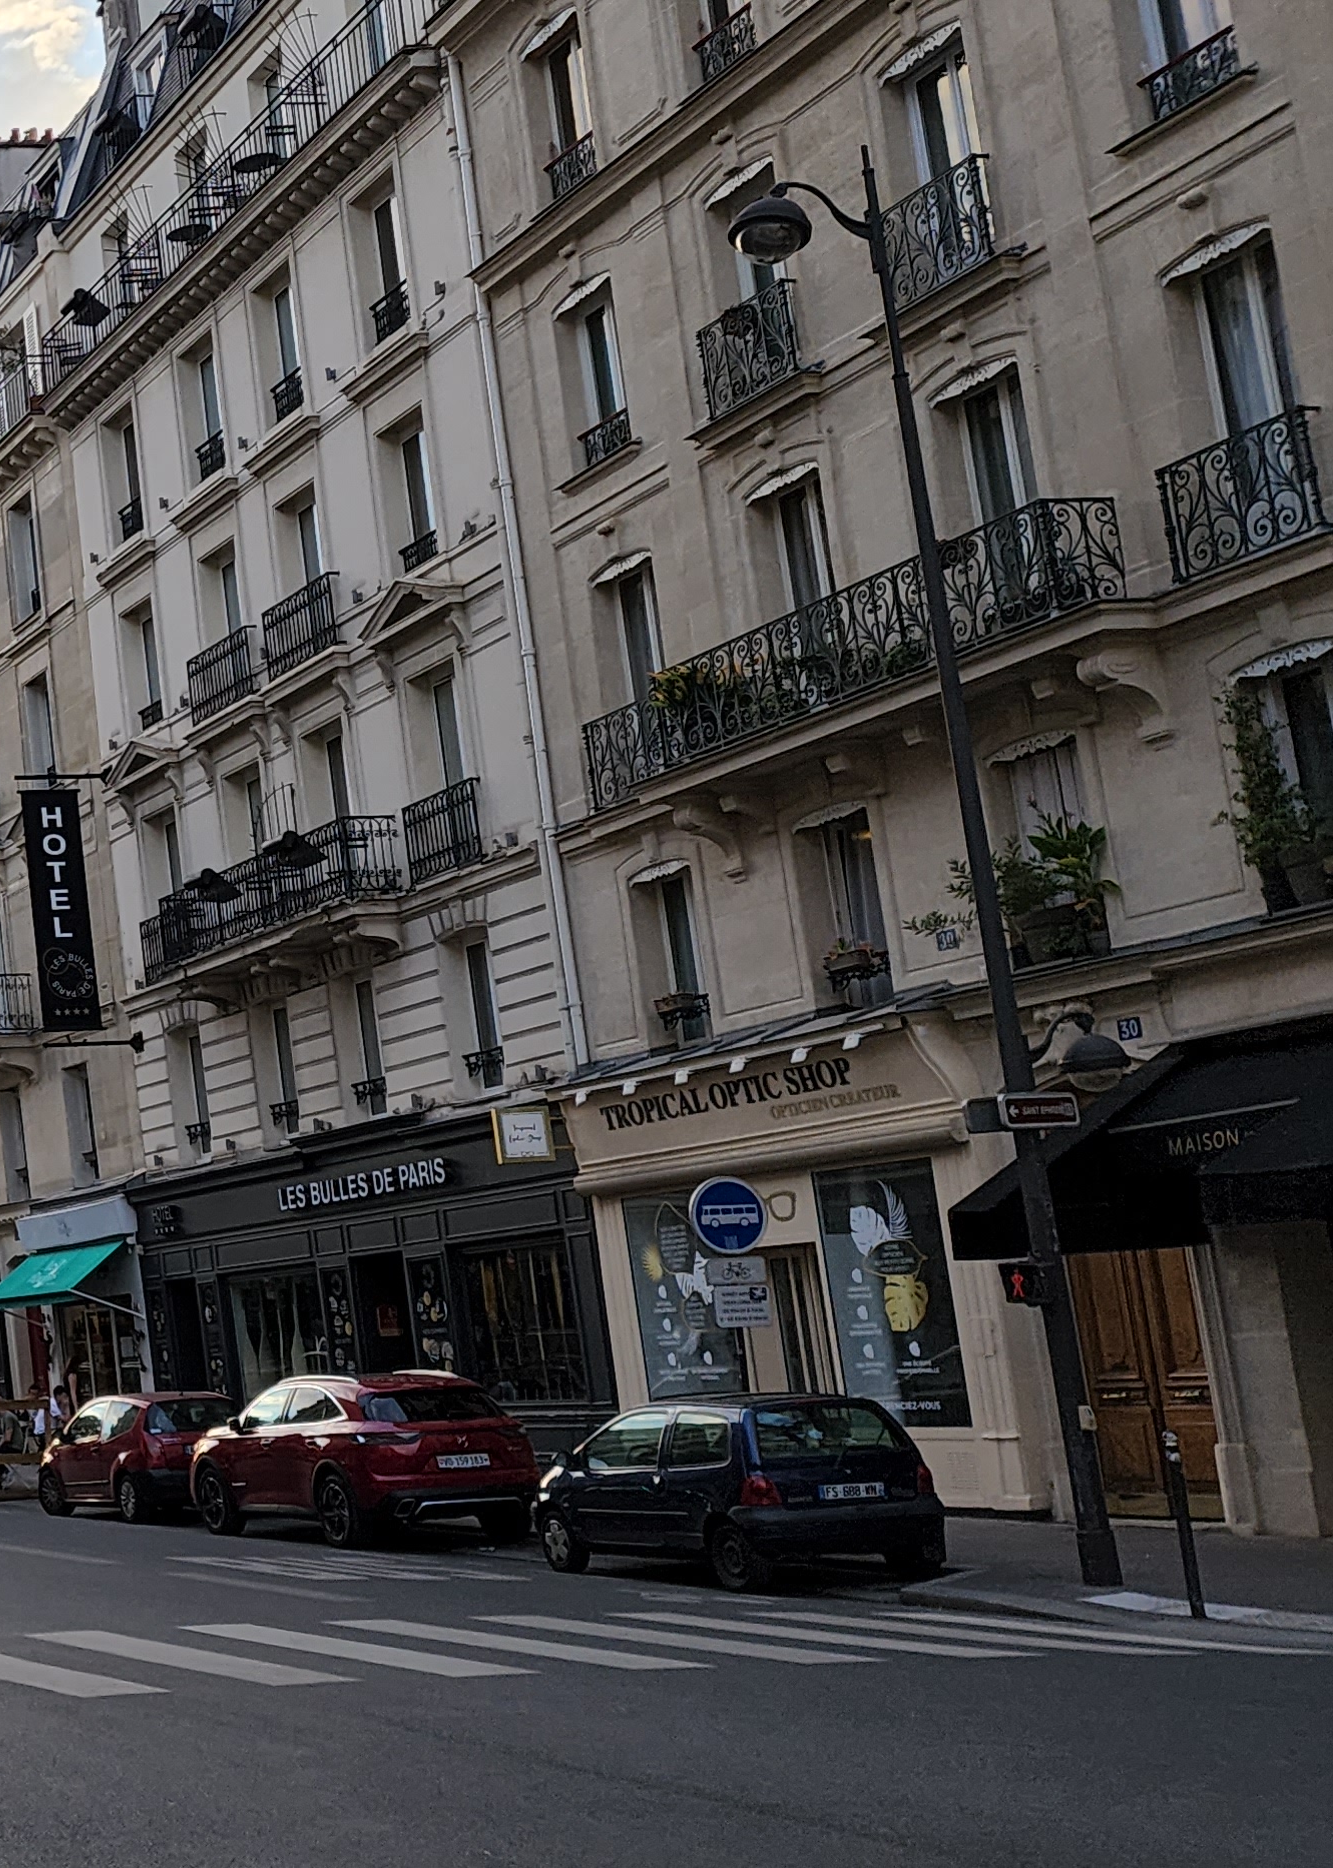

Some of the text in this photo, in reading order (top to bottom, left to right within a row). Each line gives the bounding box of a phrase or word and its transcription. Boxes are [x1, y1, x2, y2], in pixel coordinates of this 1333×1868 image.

[40, 806, 73, 938] HOTEL
[50, 954, 66, 970] LES
[68, 953, 94, 980] BULLES
[52, 980, 77, 998] PARIS
[1119, 1019, 1140, 1039] 30
[600, 1056, 851, 1131] TROPICAL OPTIC SHOP
[770, 1096, 830, 1120] OPTICIEN
[1167, 1127, 1240, 1157] MAISON
[277, 1157, 447, 1212] LES BULLES DE PARIS
